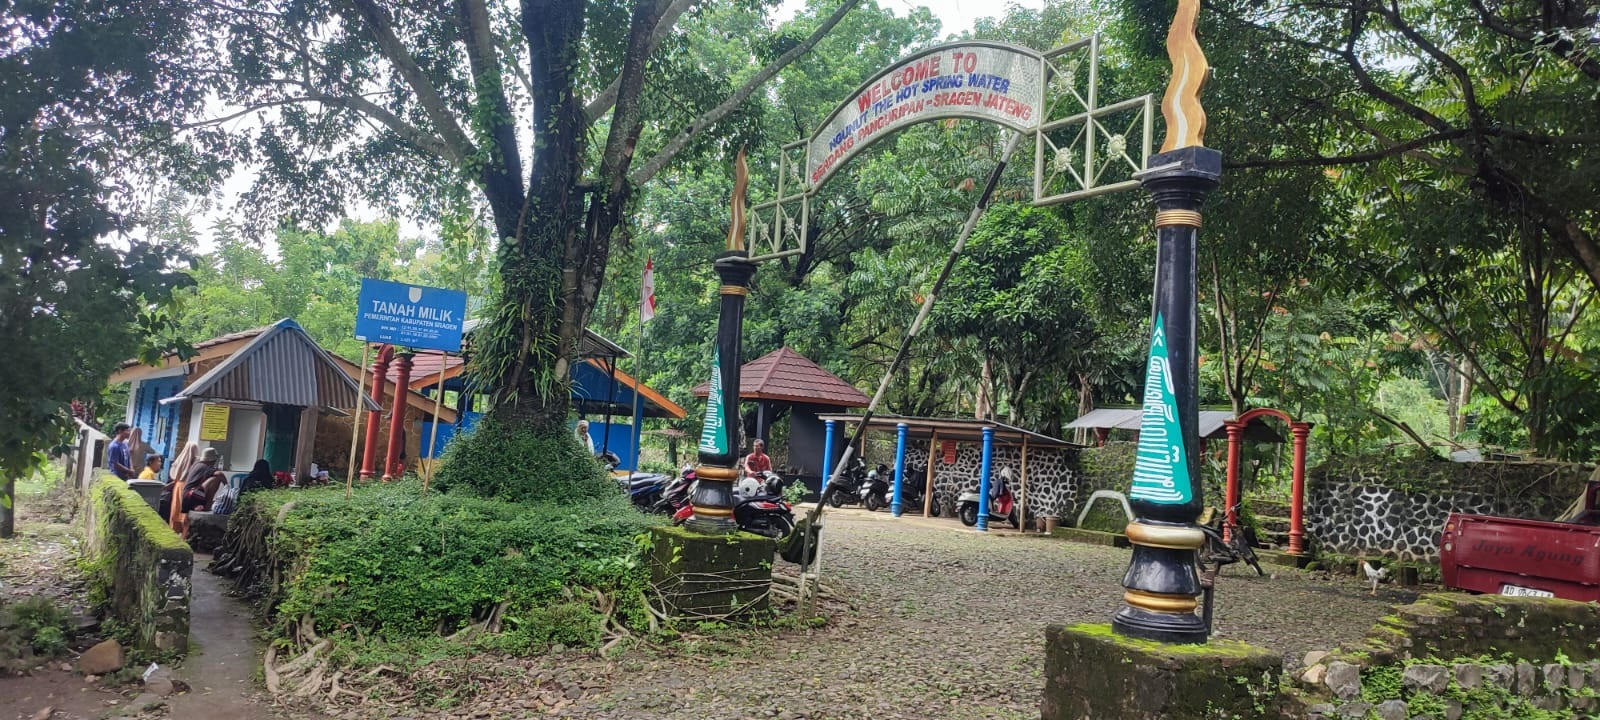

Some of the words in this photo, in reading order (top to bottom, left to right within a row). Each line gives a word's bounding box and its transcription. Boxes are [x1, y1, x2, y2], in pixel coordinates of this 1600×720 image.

[829, 110, 869, 151] NGUNUT
[873, 95, 894, 116] THE
[895, 84, 919, 103] HOT
[921, 74, 963, 93] SPRING
[968, 73, 1010, 94] WATER
[857, 56, 941, 113] WELCOME
[952, 52, 977, 74] TO
[811, 136, 854, 184] SENDANG
[857, 98, 924, 141] PANGURIPAN
[933, 91, 982, 107] SRAGEN
[983, 93, 1033, 121] JATENG
[363, 312, 400, 323] PEMERINTAH
[400, 317, 434, 327] KABUPATEN
[434, 322, 458, 331] SRAGEN
[372, 299, 415, 318] TANAH
[418, 306, 453, 323] MILIK
